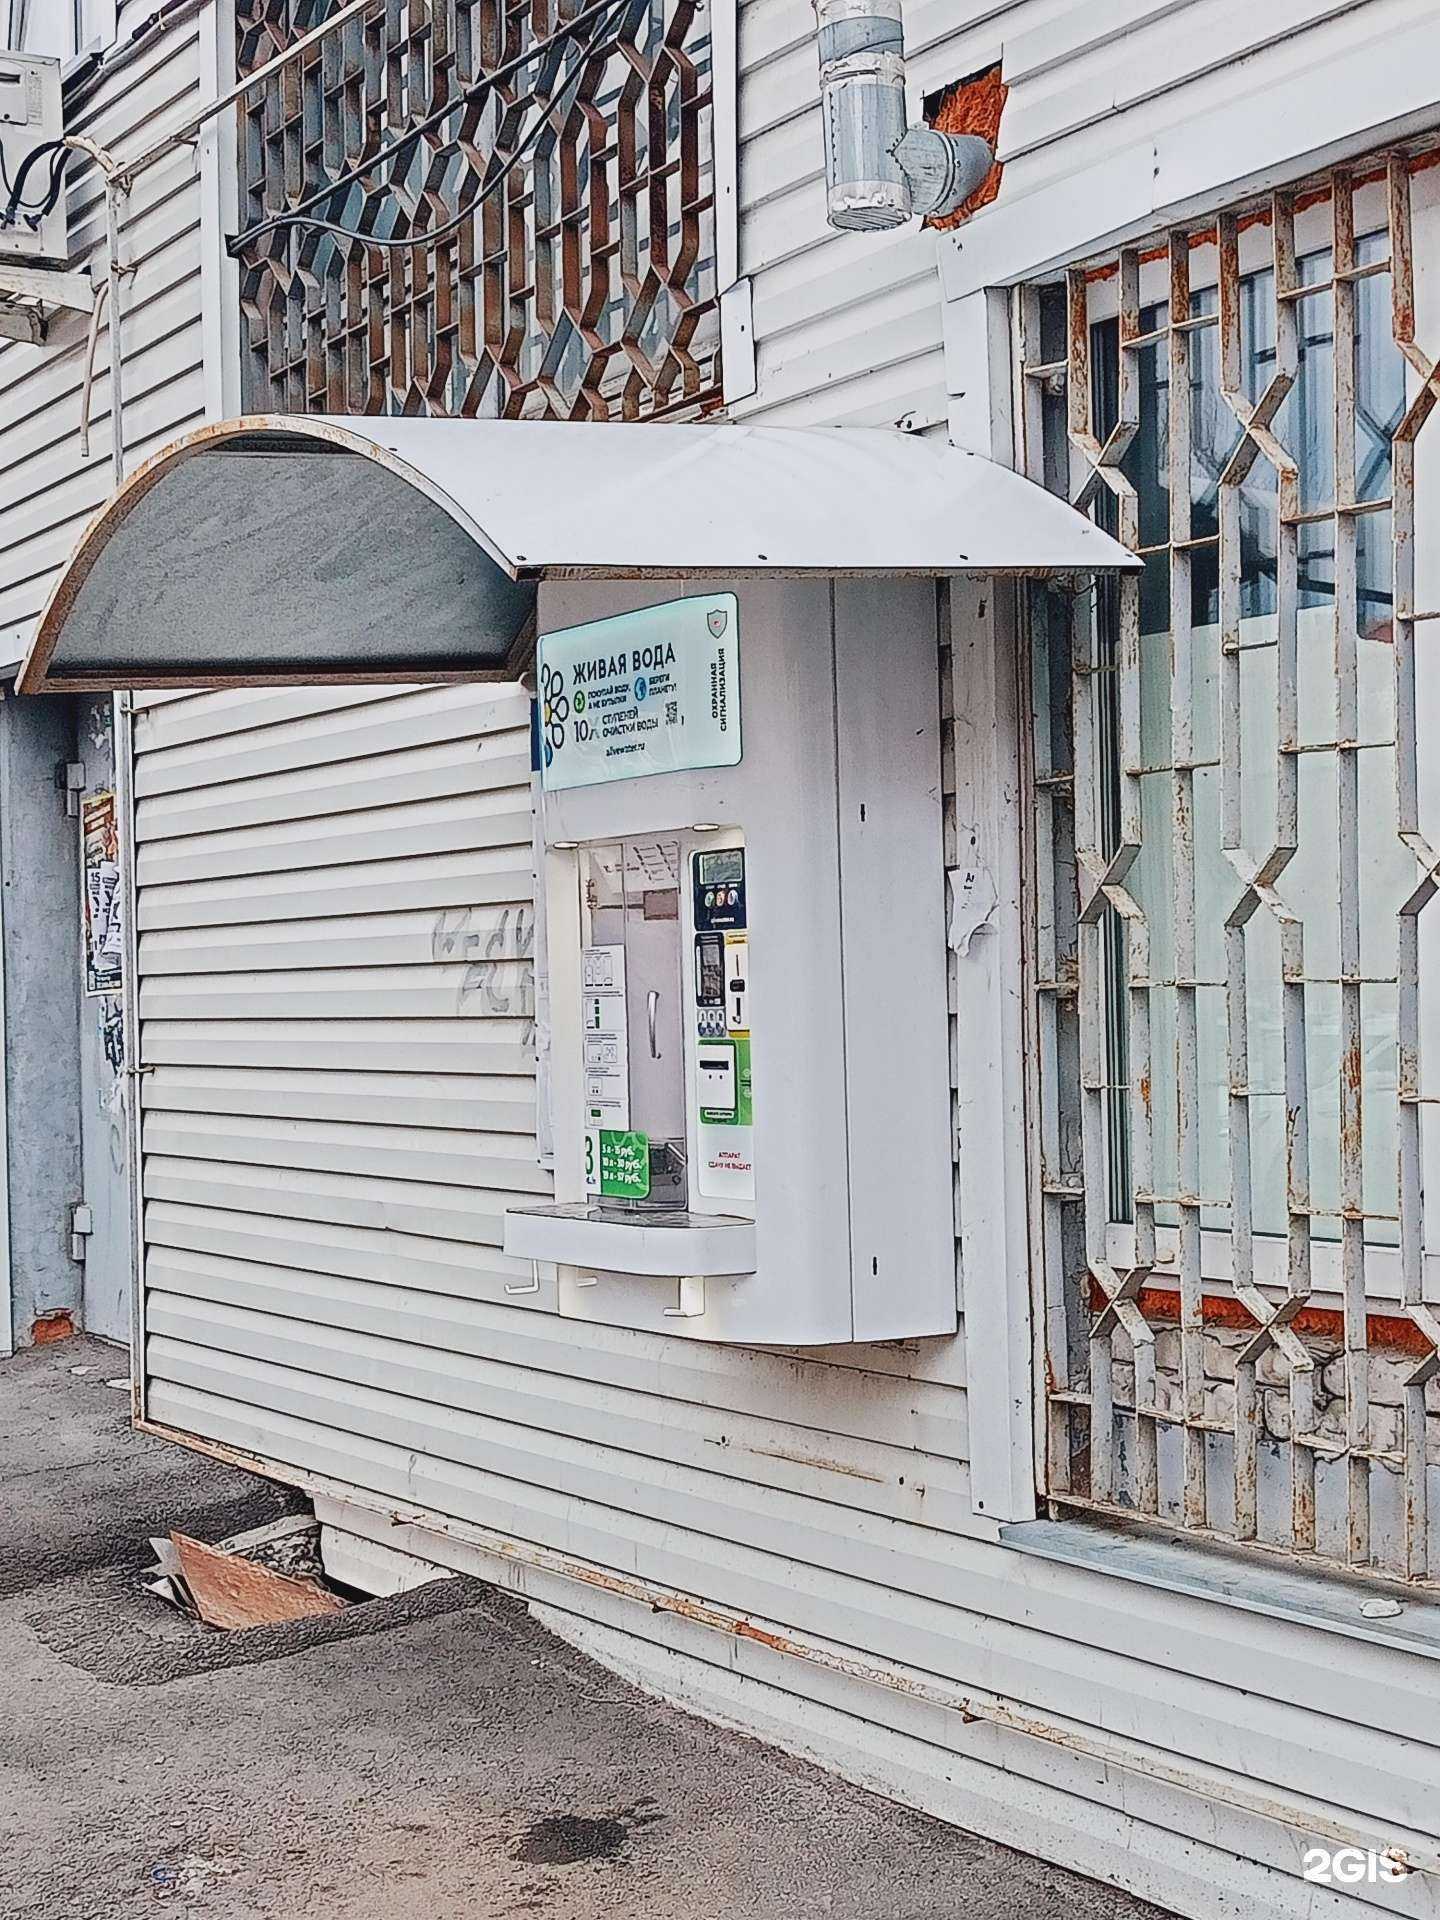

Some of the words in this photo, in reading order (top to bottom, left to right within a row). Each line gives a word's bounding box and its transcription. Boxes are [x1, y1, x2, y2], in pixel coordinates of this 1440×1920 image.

[573, 653, 627, 685] ЖИВАЯ
[632, 642, 676, 671] ВОДА
[710, 662, 719, 719] ОХРАННАЯ
[718, 648, 727, 732] СИГНАЛИЗАЦИЯ
[573, 720, 588, 742] 10
[602, 706, 639, 725] СТУПЕНЕЙ
[602, 723, 635, 737] ОЧИСТКИ
[637, 718, 659, 731] ВОДЫ
